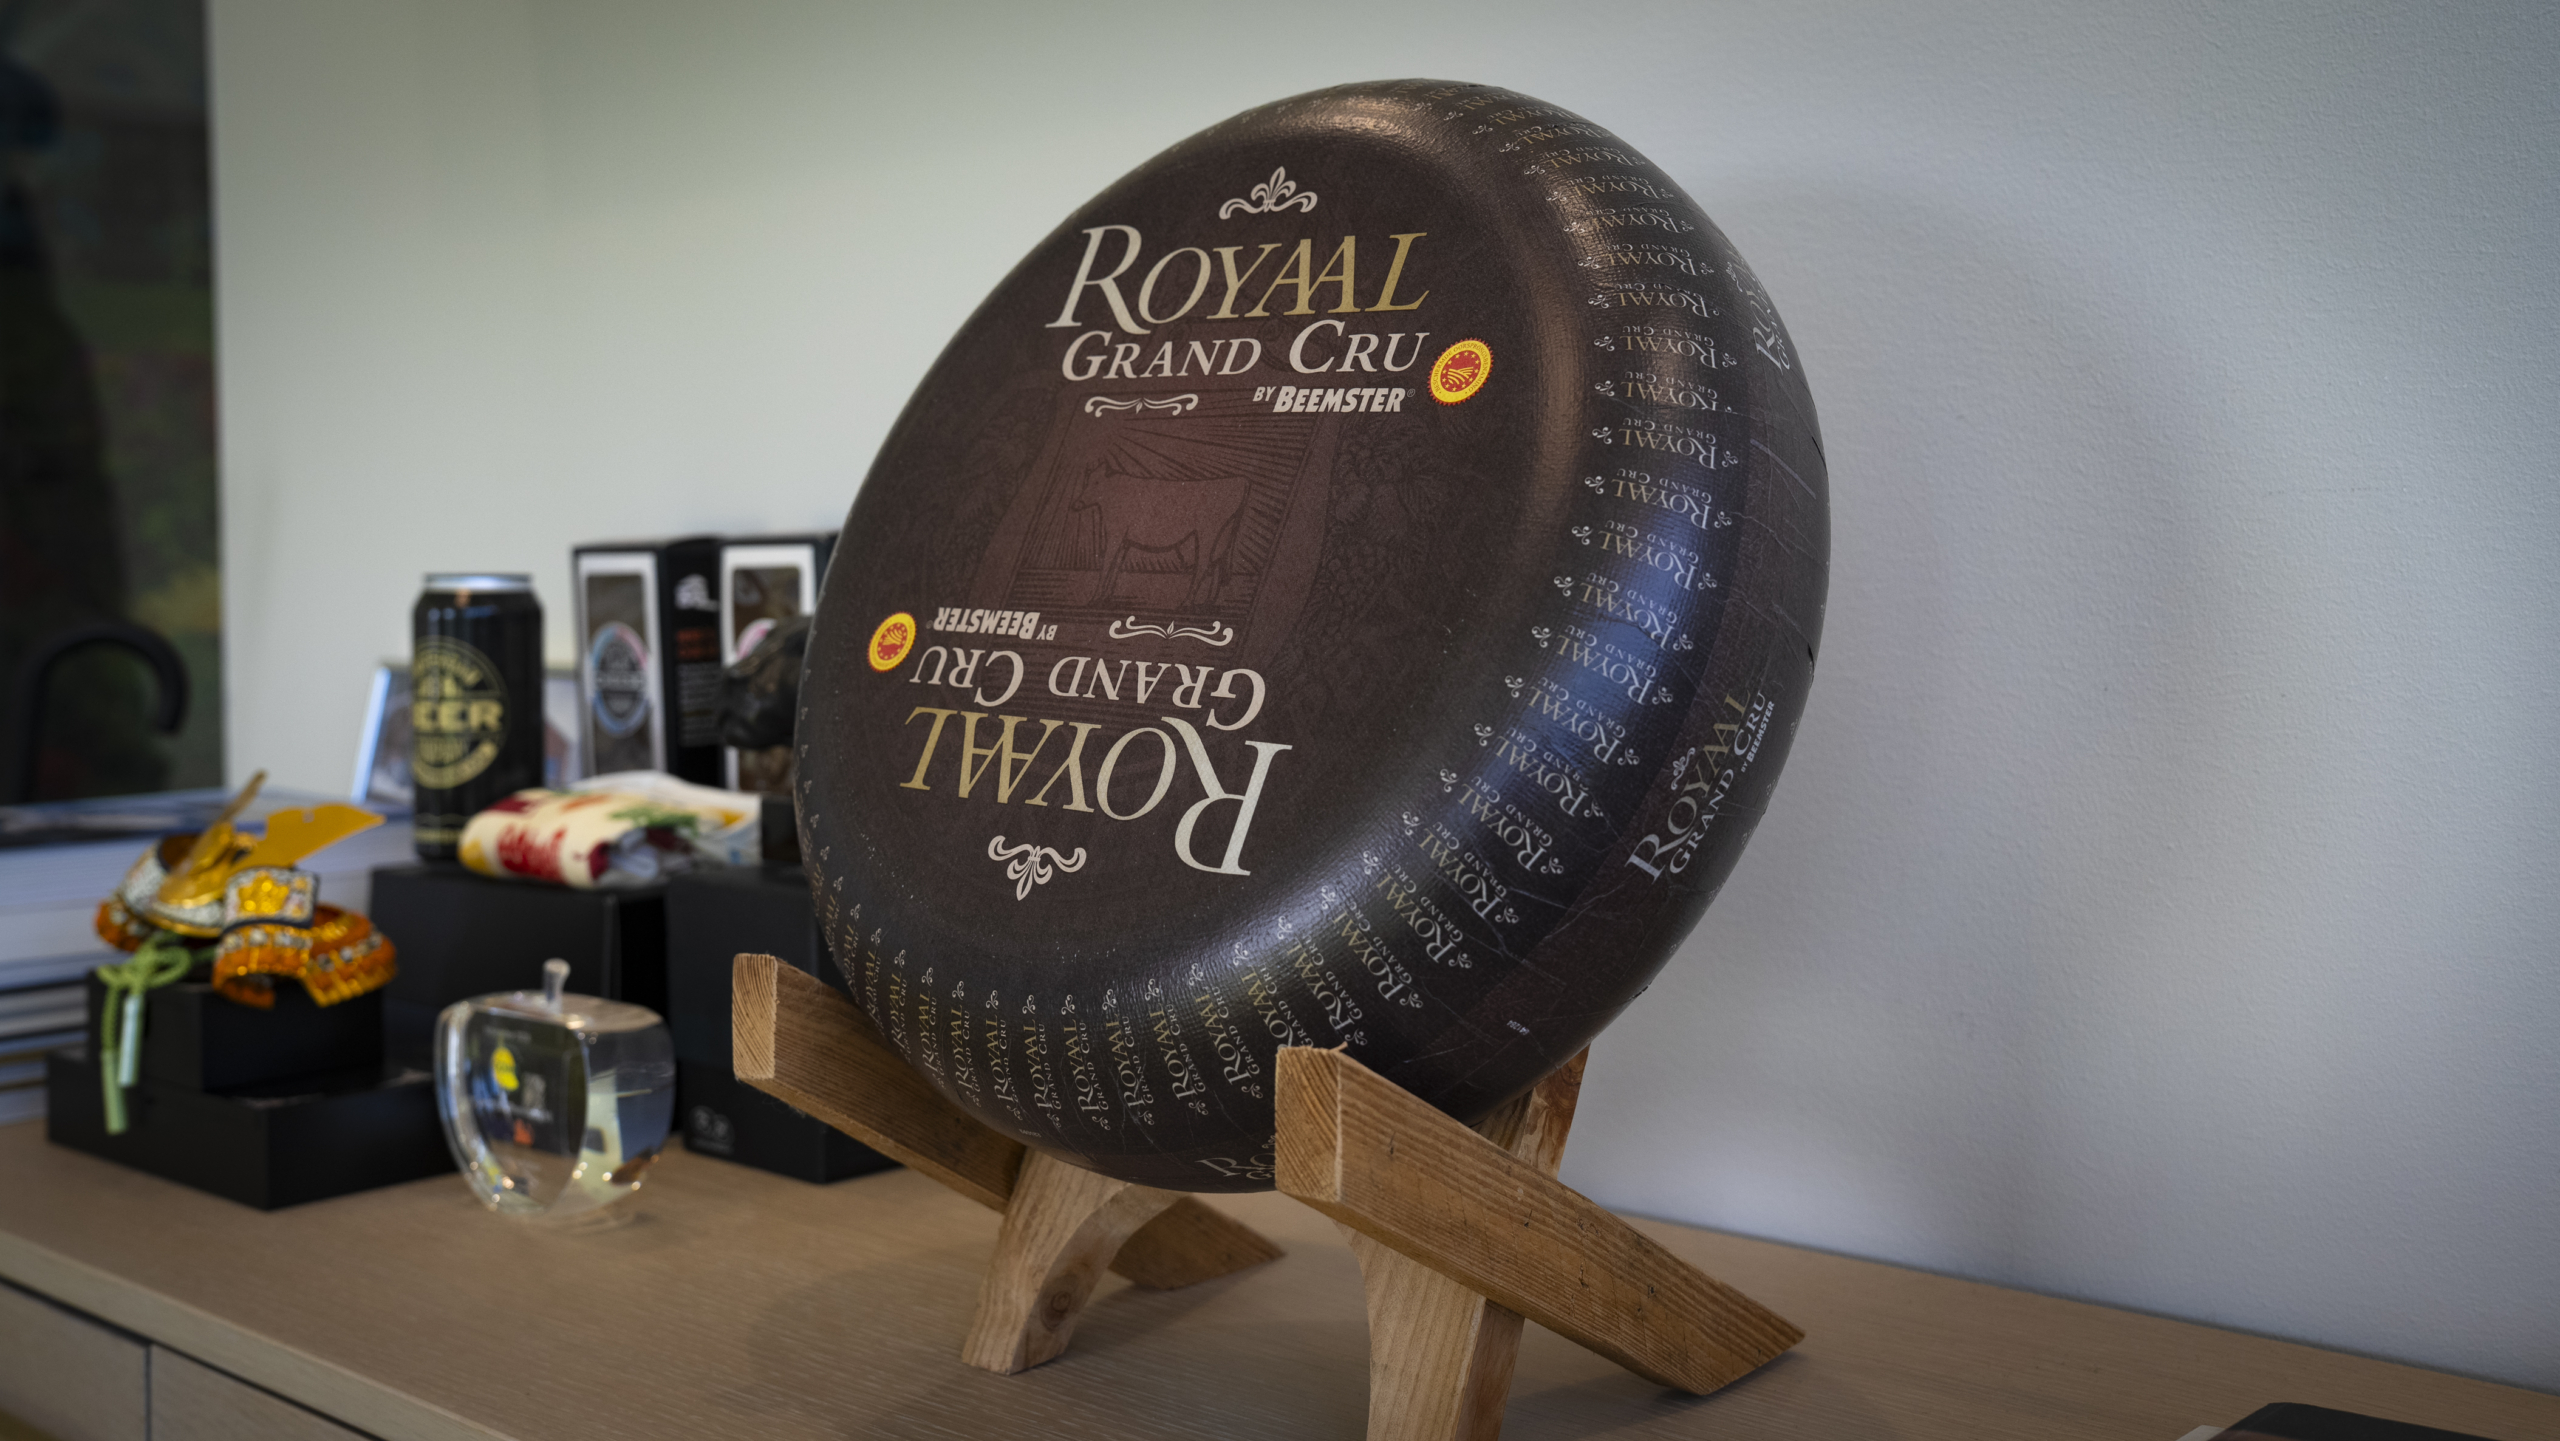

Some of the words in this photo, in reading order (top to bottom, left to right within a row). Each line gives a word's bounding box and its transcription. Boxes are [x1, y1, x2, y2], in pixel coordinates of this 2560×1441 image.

[1045, 223, 1430, 335] ROYAAL
[1061, 329, 1262, 382] GRAND
[1287, 319, 1430, 374] CRU
[1253, 386, 1275, 403] BY
[1038, 624, 1058, 641] BY
[909, 645, 1024, 707] CRU
[1048, 656, 1266, 731] GRAND
[1741, 761, 1748, 773] BY
[1747, 700, 1775, 763] BEEMSTER
[900, 706, 1293, 876] ROYAAL
[1624, 688, 1751, 885] ROYAAL
[1669, 768, 1734, 874] GRAND
[1733, 690, 1766, 756] CRU
